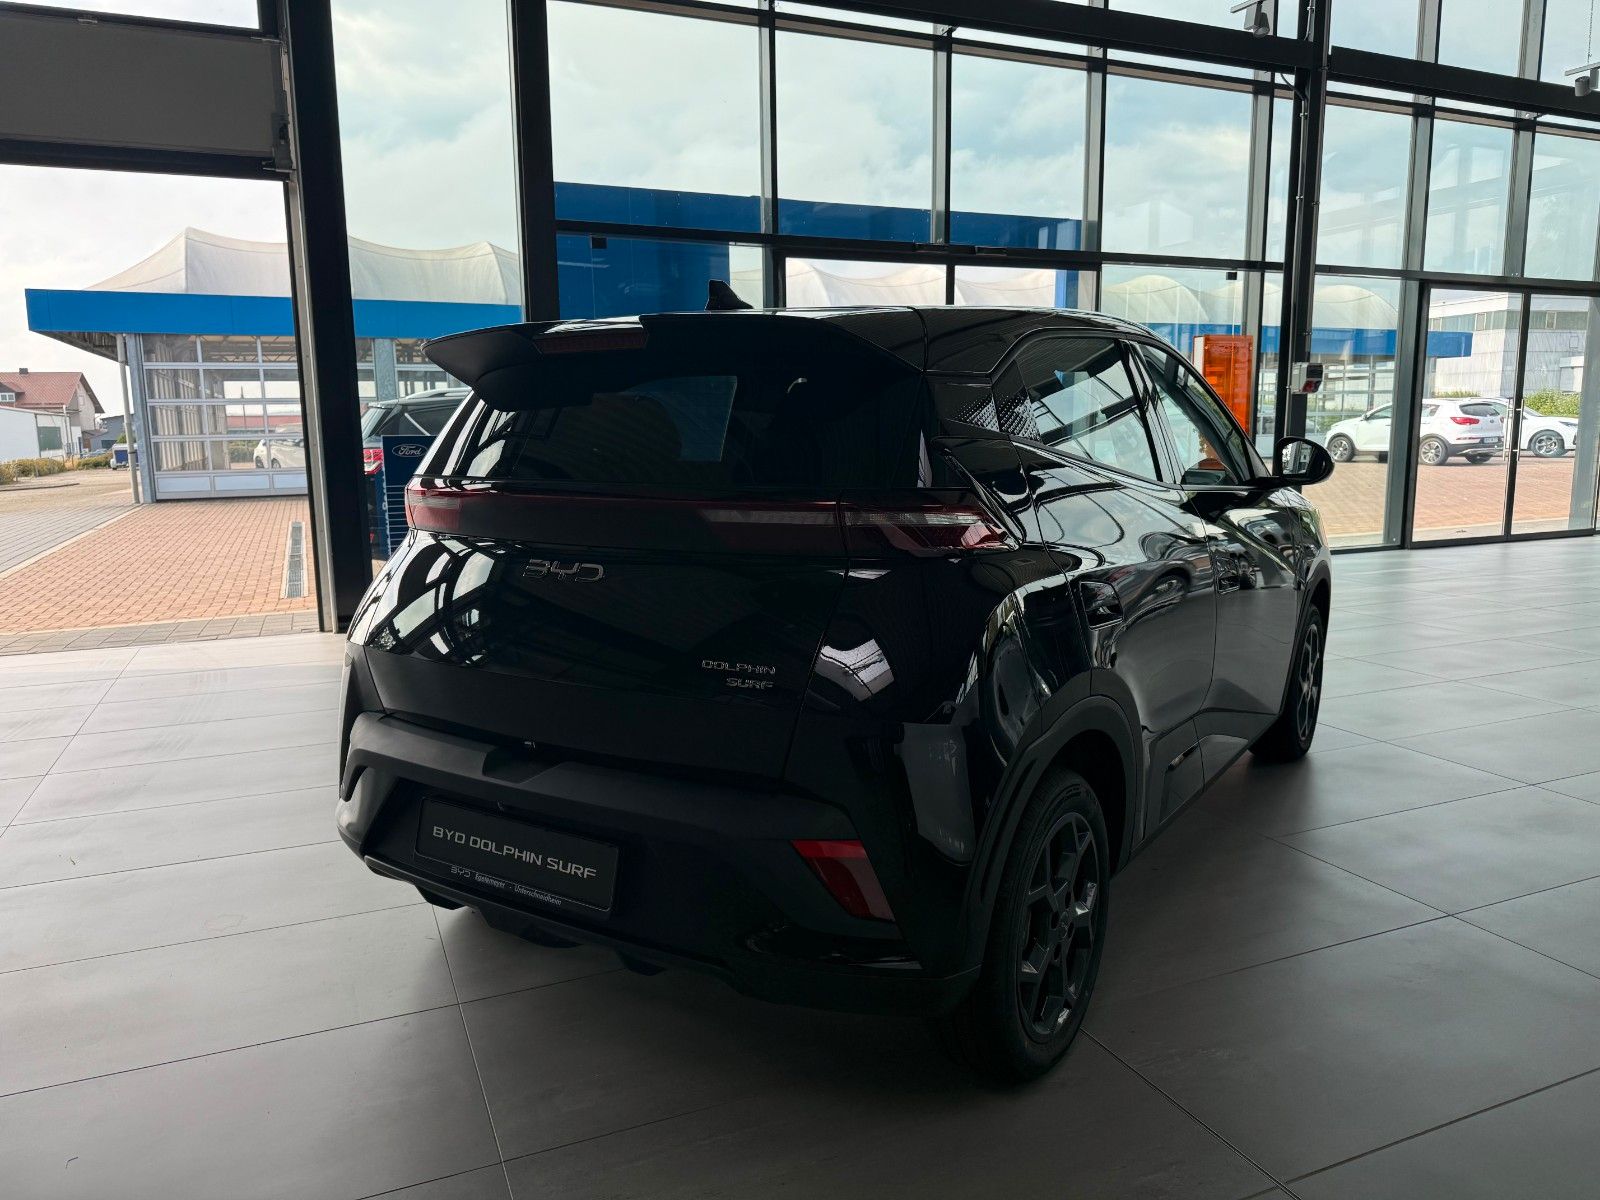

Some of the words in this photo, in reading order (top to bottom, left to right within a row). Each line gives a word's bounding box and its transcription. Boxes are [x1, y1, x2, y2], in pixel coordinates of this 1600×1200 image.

[398, 445, 422, 456] Ford
[522, 559, 605, 582] BYD
[702, 659, 777, 675] DOLPHIN
[726, 677, 774, 690] SURF
[432, 825, 465, 845] BYD
[469, 836, 543, 866] DOLPHIN
[546, 857, 598, 880] SURF
[450, 865, 471, 878] BYD
